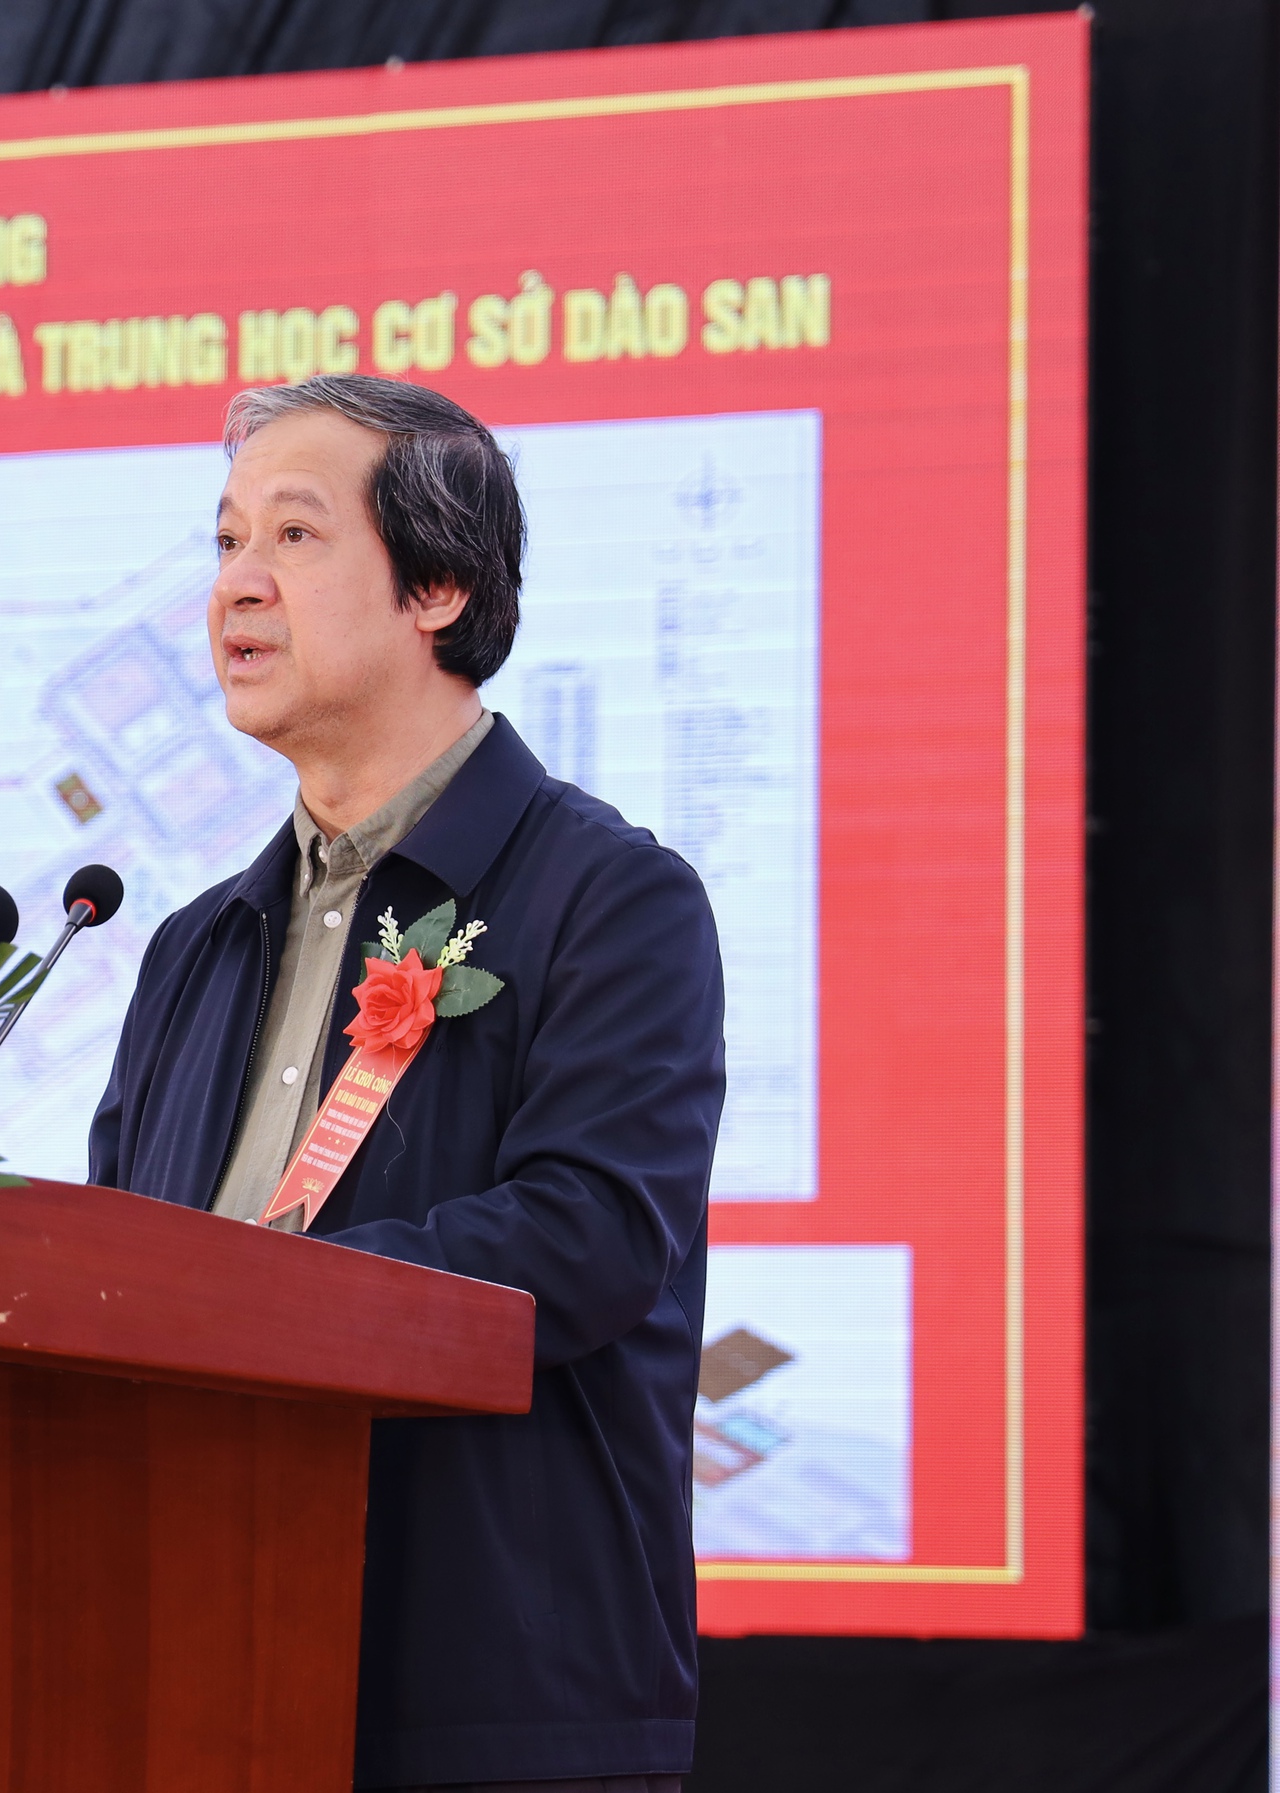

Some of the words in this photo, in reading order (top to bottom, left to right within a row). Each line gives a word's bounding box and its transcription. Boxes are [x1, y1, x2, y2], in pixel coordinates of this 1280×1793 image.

[34, 313, 228, 393] TRUNG
[239, 303, 360, 383] HỌC
[372, 290, 457, 373] CƠ
[466, 268, 554, 368] SỞ
[563, 271, 688, 364] DÀO
[702, 273, 832, 355] SAN
